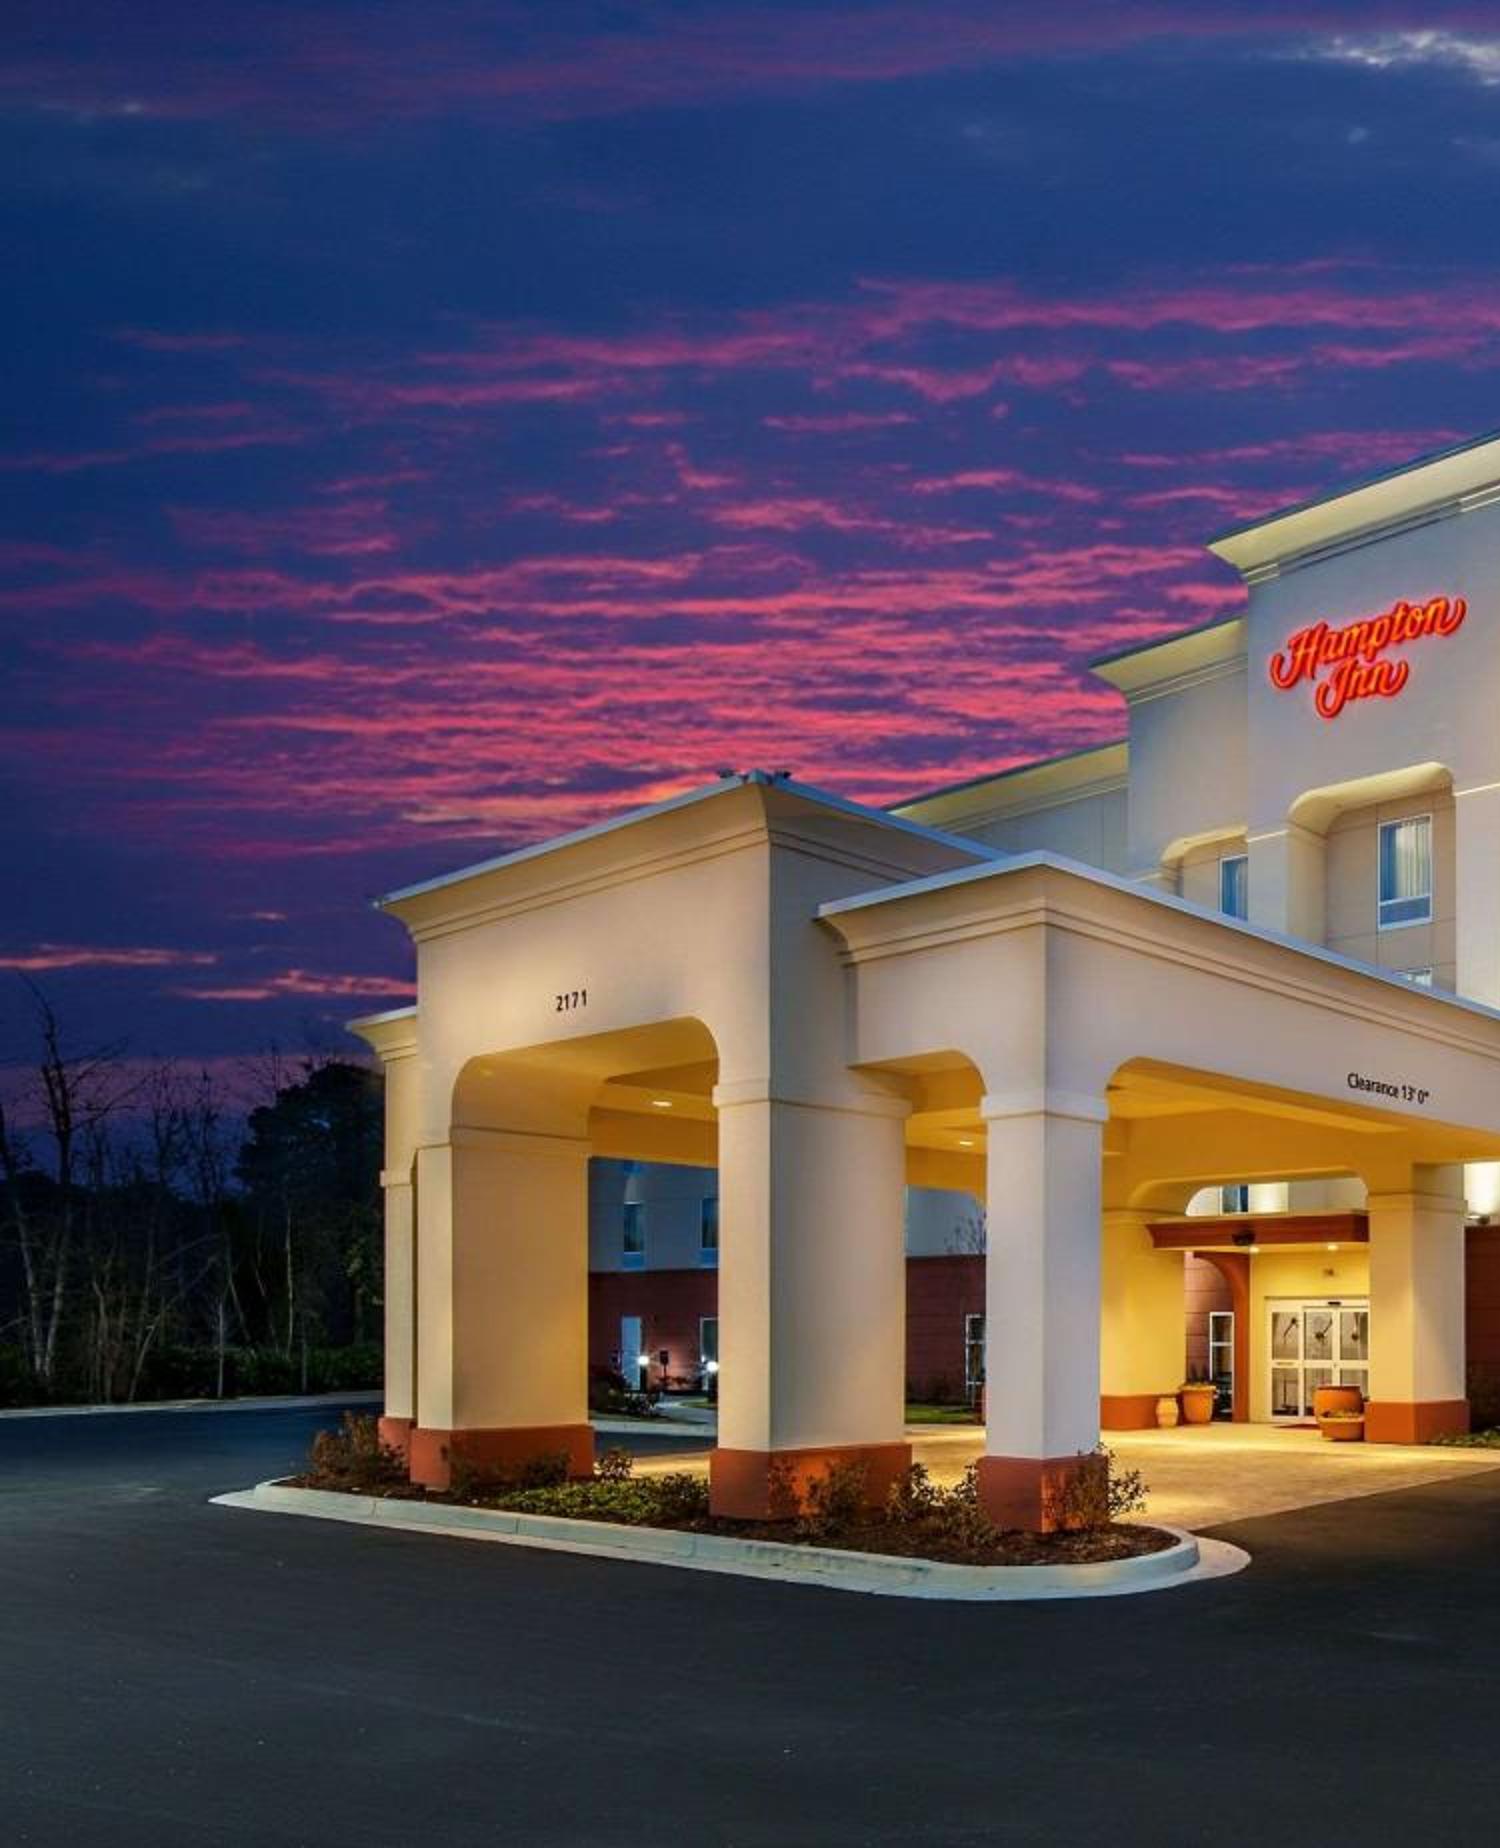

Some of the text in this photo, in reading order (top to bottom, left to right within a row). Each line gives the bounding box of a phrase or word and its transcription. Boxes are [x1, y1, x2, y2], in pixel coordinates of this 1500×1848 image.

[1270, 596, 1467, 688] Hampton
[1315, 660, 1409, 718] Inn
[555, 989, 587, 1012] 2171
[1347, 1073, 1399, 1098] Clearance
